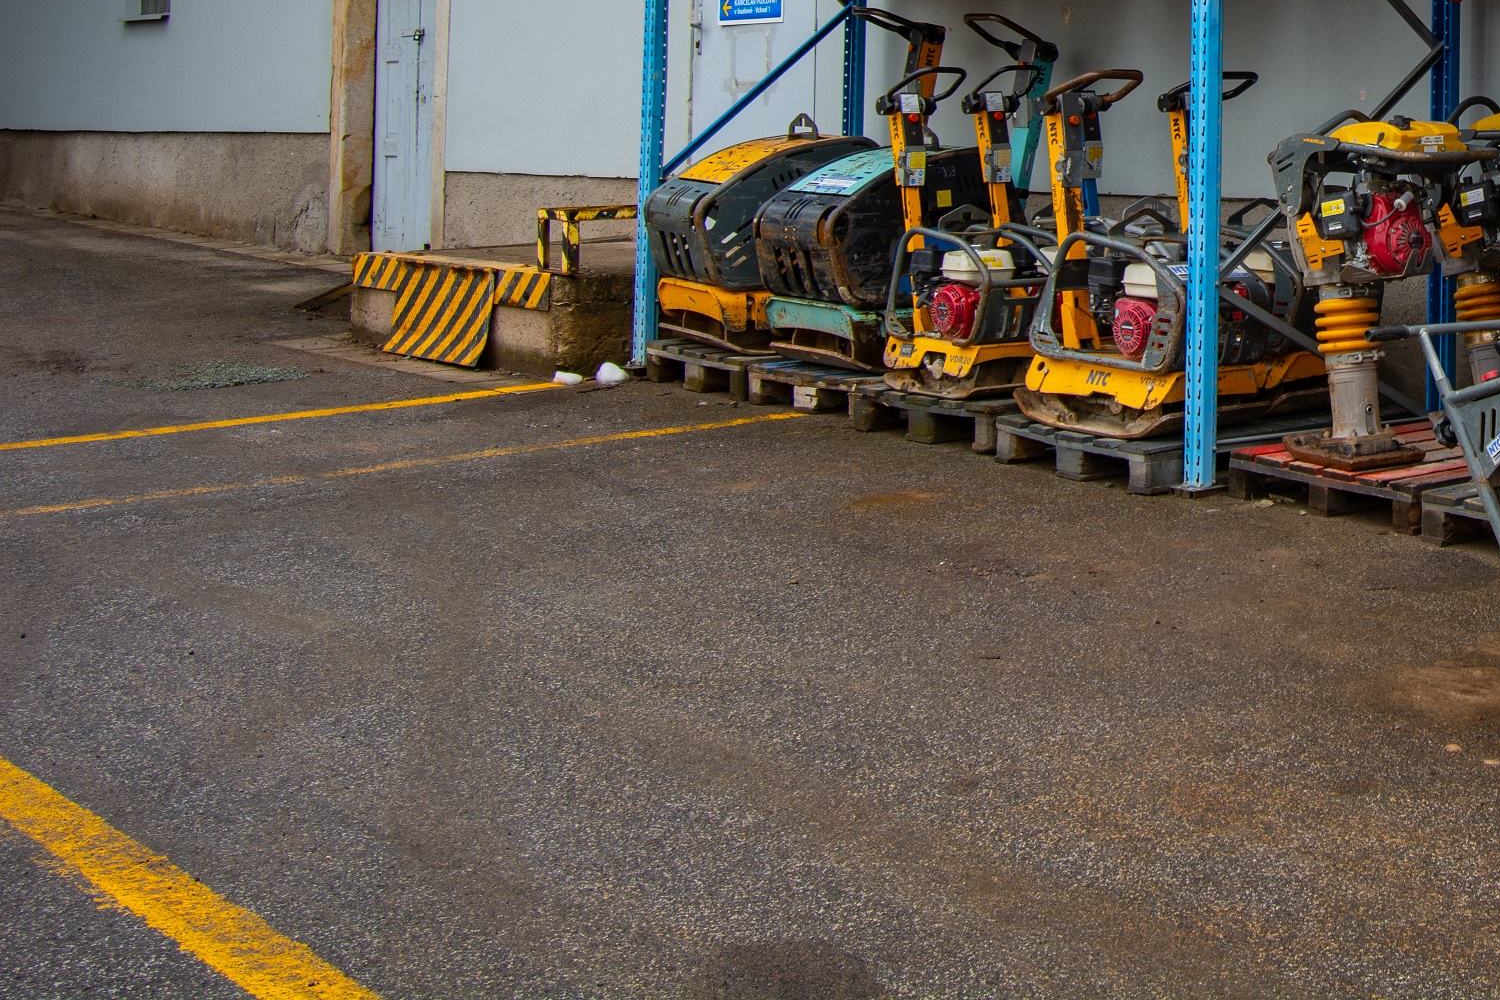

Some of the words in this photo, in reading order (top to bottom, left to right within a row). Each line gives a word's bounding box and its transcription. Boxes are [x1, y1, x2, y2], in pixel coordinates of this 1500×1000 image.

[925, 48, 935, 67] NTC
[892, 117, 900, 141] NTC
[977, 116, 985, 140] NTC
[1049, 122, 1058, 145] NTC
[1172, 118, 1181, 140] NTC
[1170, 265, 1188, 273] NT
[949, 354, 972, 365] VDR20
[1085, 369, 1111, 387] NTC
[1139, 375, 1168, 388] VDR32
